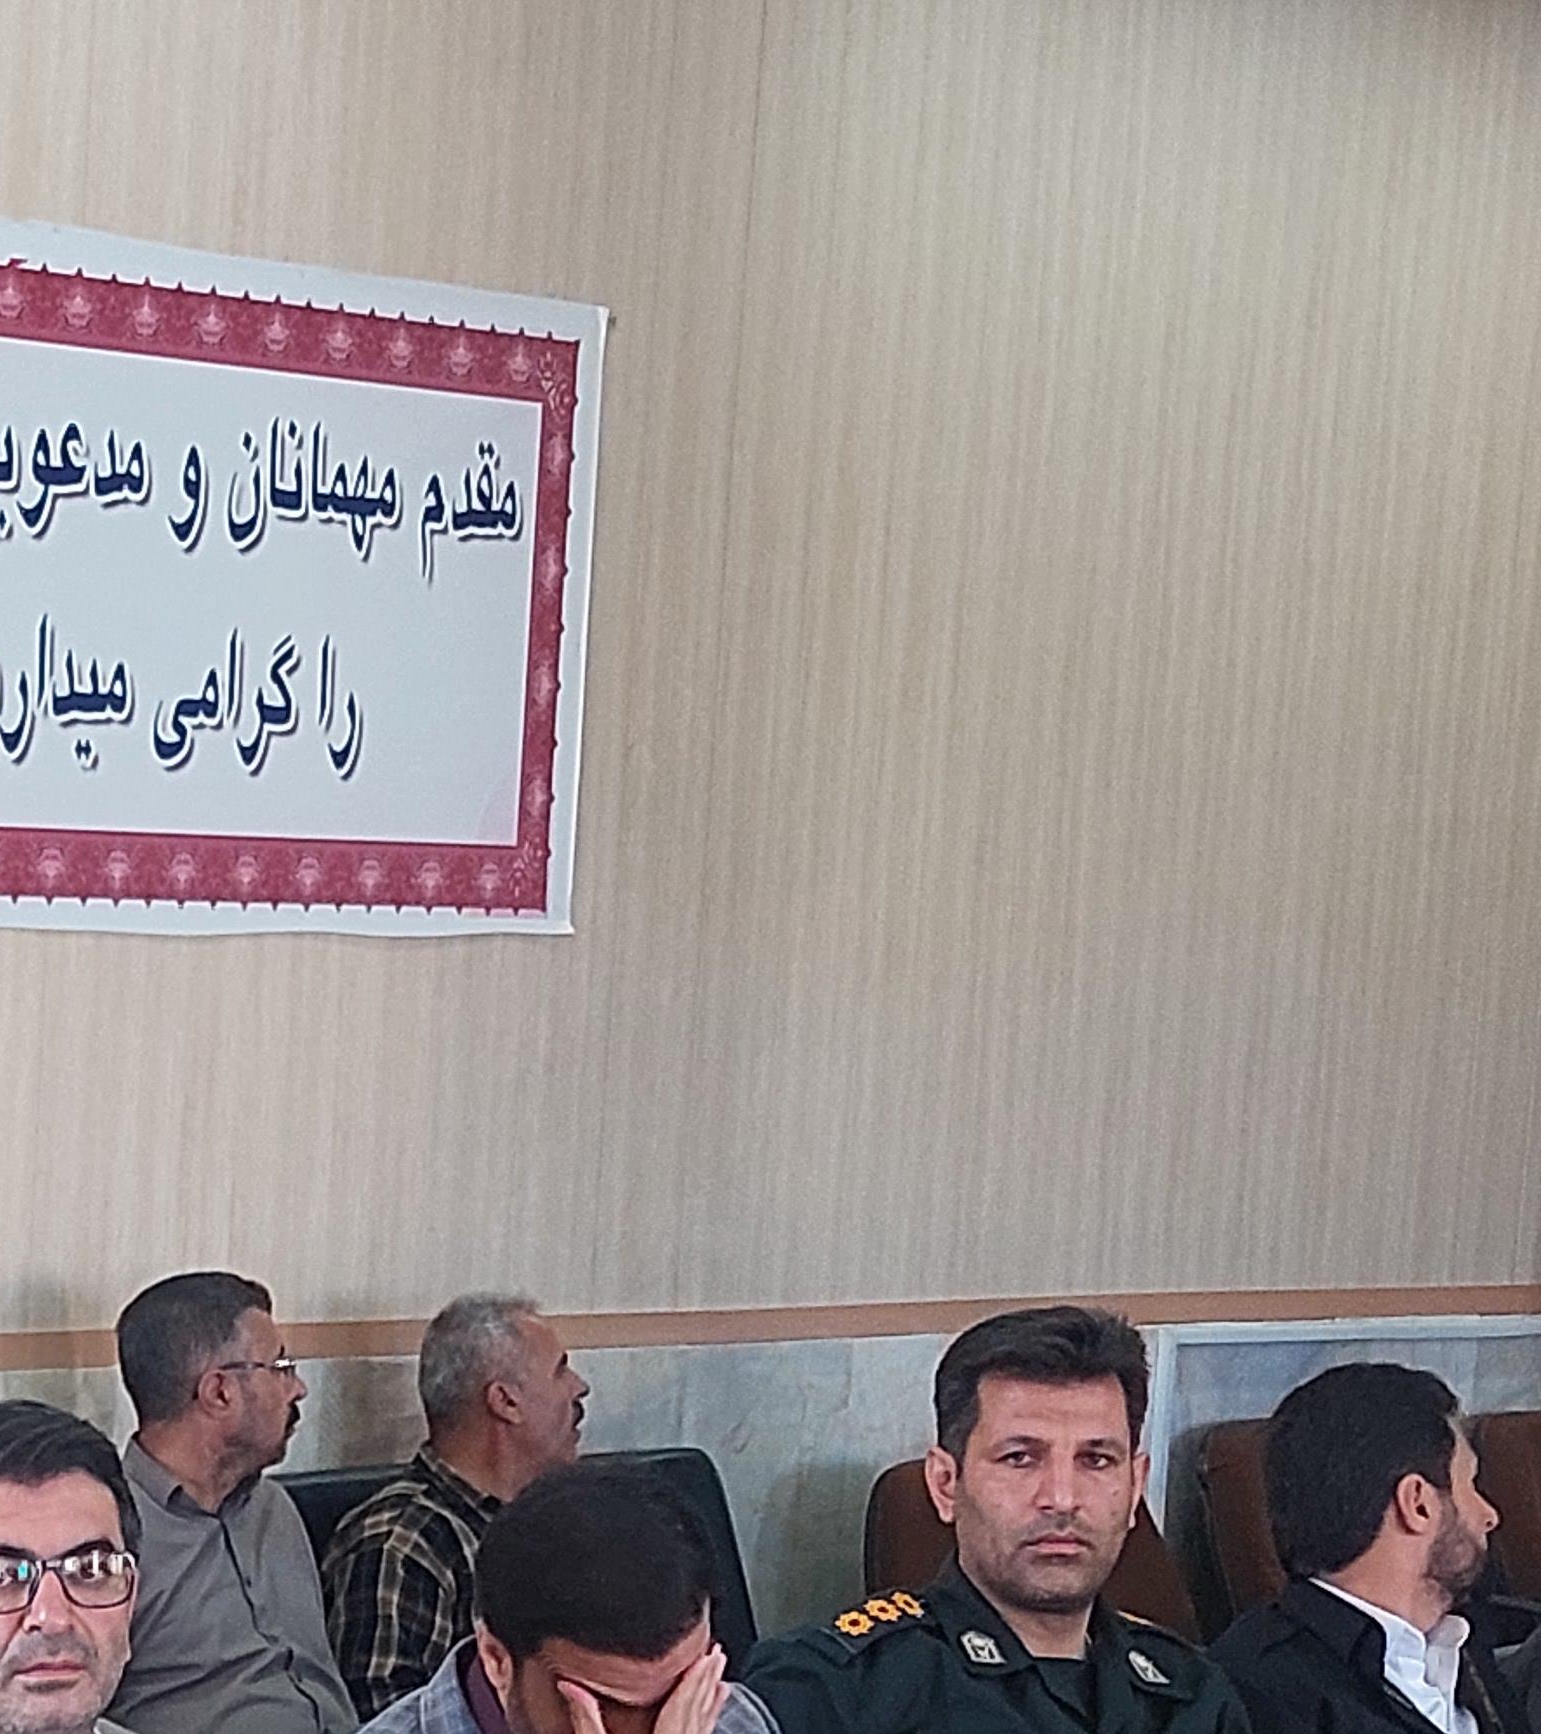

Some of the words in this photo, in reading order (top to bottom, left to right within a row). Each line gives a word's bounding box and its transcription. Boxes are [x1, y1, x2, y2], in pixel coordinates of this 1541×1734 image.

[168, 444, 206, 550] و
[227, 415, 399, 560] مهمانان
[420, 441, 523, 582] مقدم
[153, 627, 301, 773] گرامی
[319, 634, 361, 778] را
